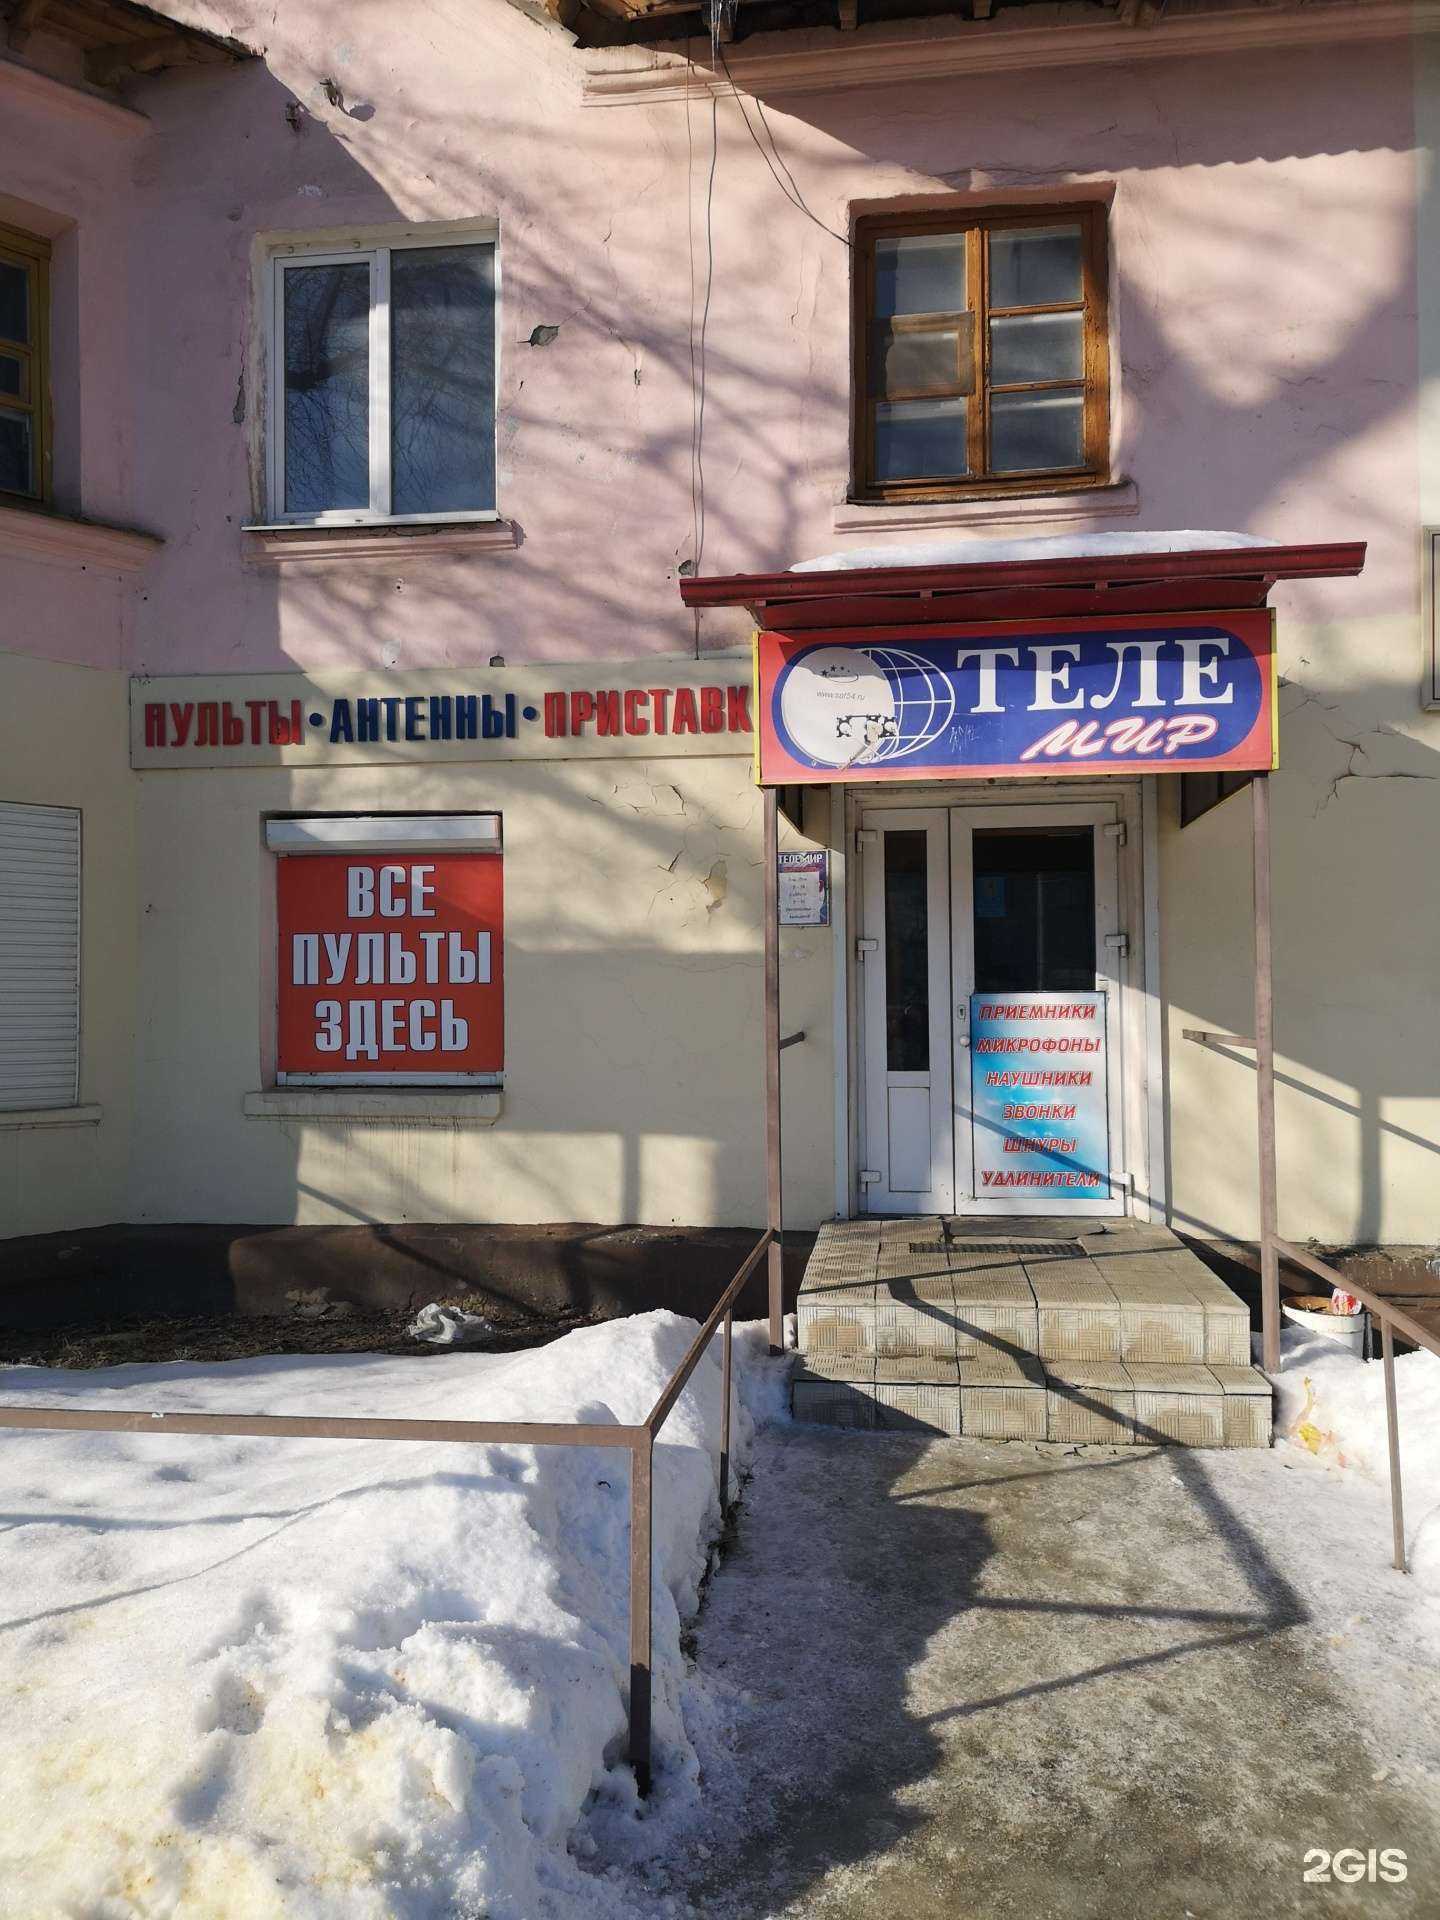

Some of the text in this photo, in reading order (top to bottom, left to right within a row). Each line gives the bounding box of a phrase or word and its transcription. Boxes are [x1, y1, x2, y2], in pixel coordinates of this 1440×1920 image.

[956, 637, 1235, 714] ТЕЛЕ
[144, 699, 304, 748] ПУЛЬТЫ
[329, 693, 516, 744] АНТЕННЫ
[346, 863, 437, 919] ВСЕ
[291, 930, 493, 986] ПУЛЬТЫ
[978, 1004, 1098, 1020] ПРИЕМНИКИ
[313, 998, 470, 1062] ЗДЕСЬ
[976, 1037, 1102, 1053] МИКРОФОНЫ
[986, 1071, 1093, 1086] НАУШНИКИ
[1003, 1104, 1077, 1120] ЗВОНКИ
[1003, 1137, 1077, 1153] ШНУРЫ
[981, 1171, 1101, 1187] УДЛИНИТЕЛИ
